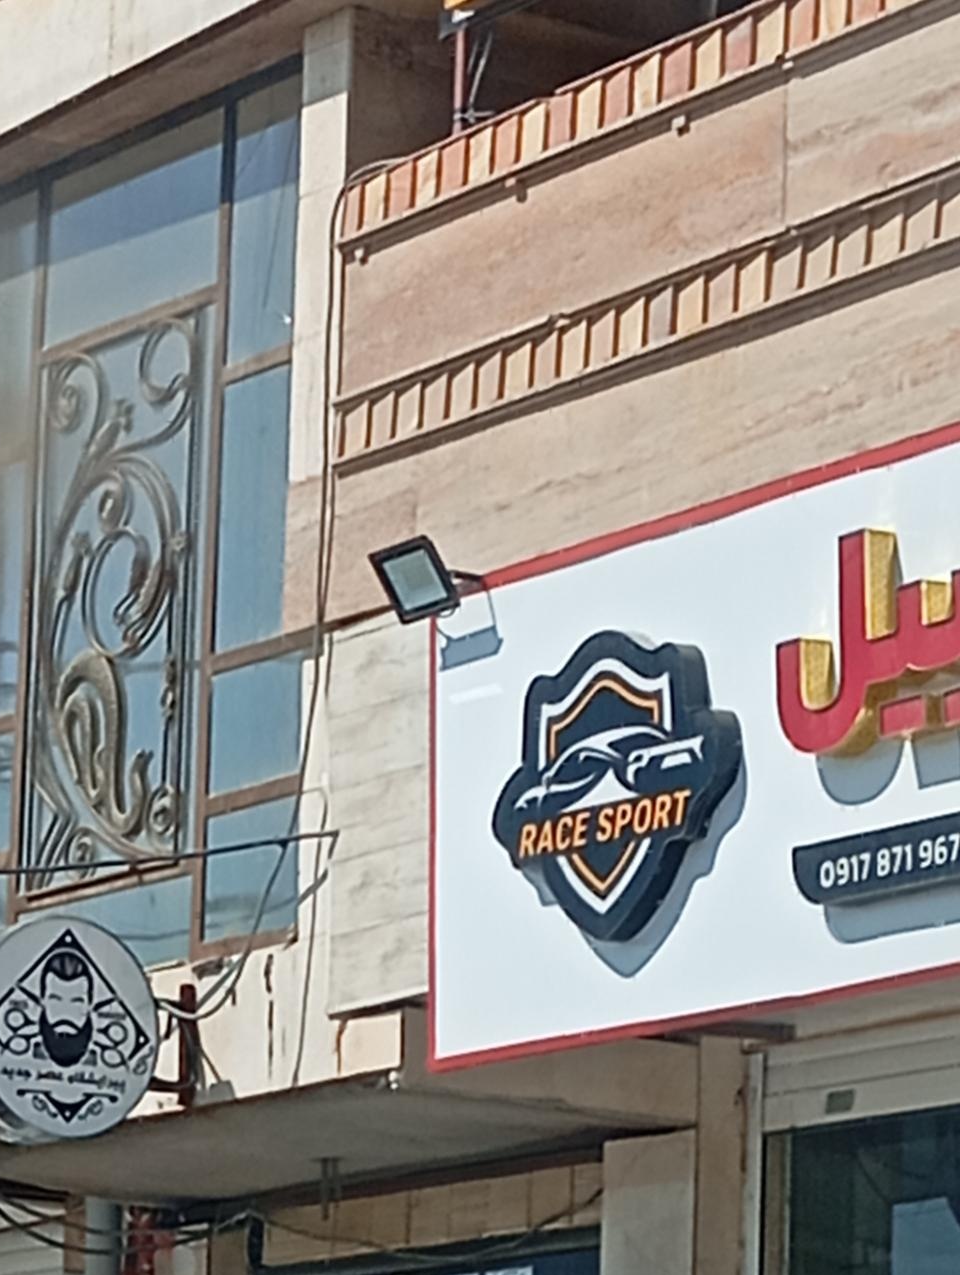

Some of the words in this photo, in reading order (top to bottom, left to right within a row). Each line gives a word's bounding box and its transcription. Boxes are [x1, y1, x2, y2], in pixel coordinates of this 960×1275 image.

[519, 812, 591, 859] RACE
[596, 789, 692, 842] SPORT
[819, 852, 871, 888] 0917
[876, 844, 913, 877] 871
[918, 833, 960, 868] 967
[0, 1065, 32, 1080] جدید
[37, 1070, 64, 1081] عصر
